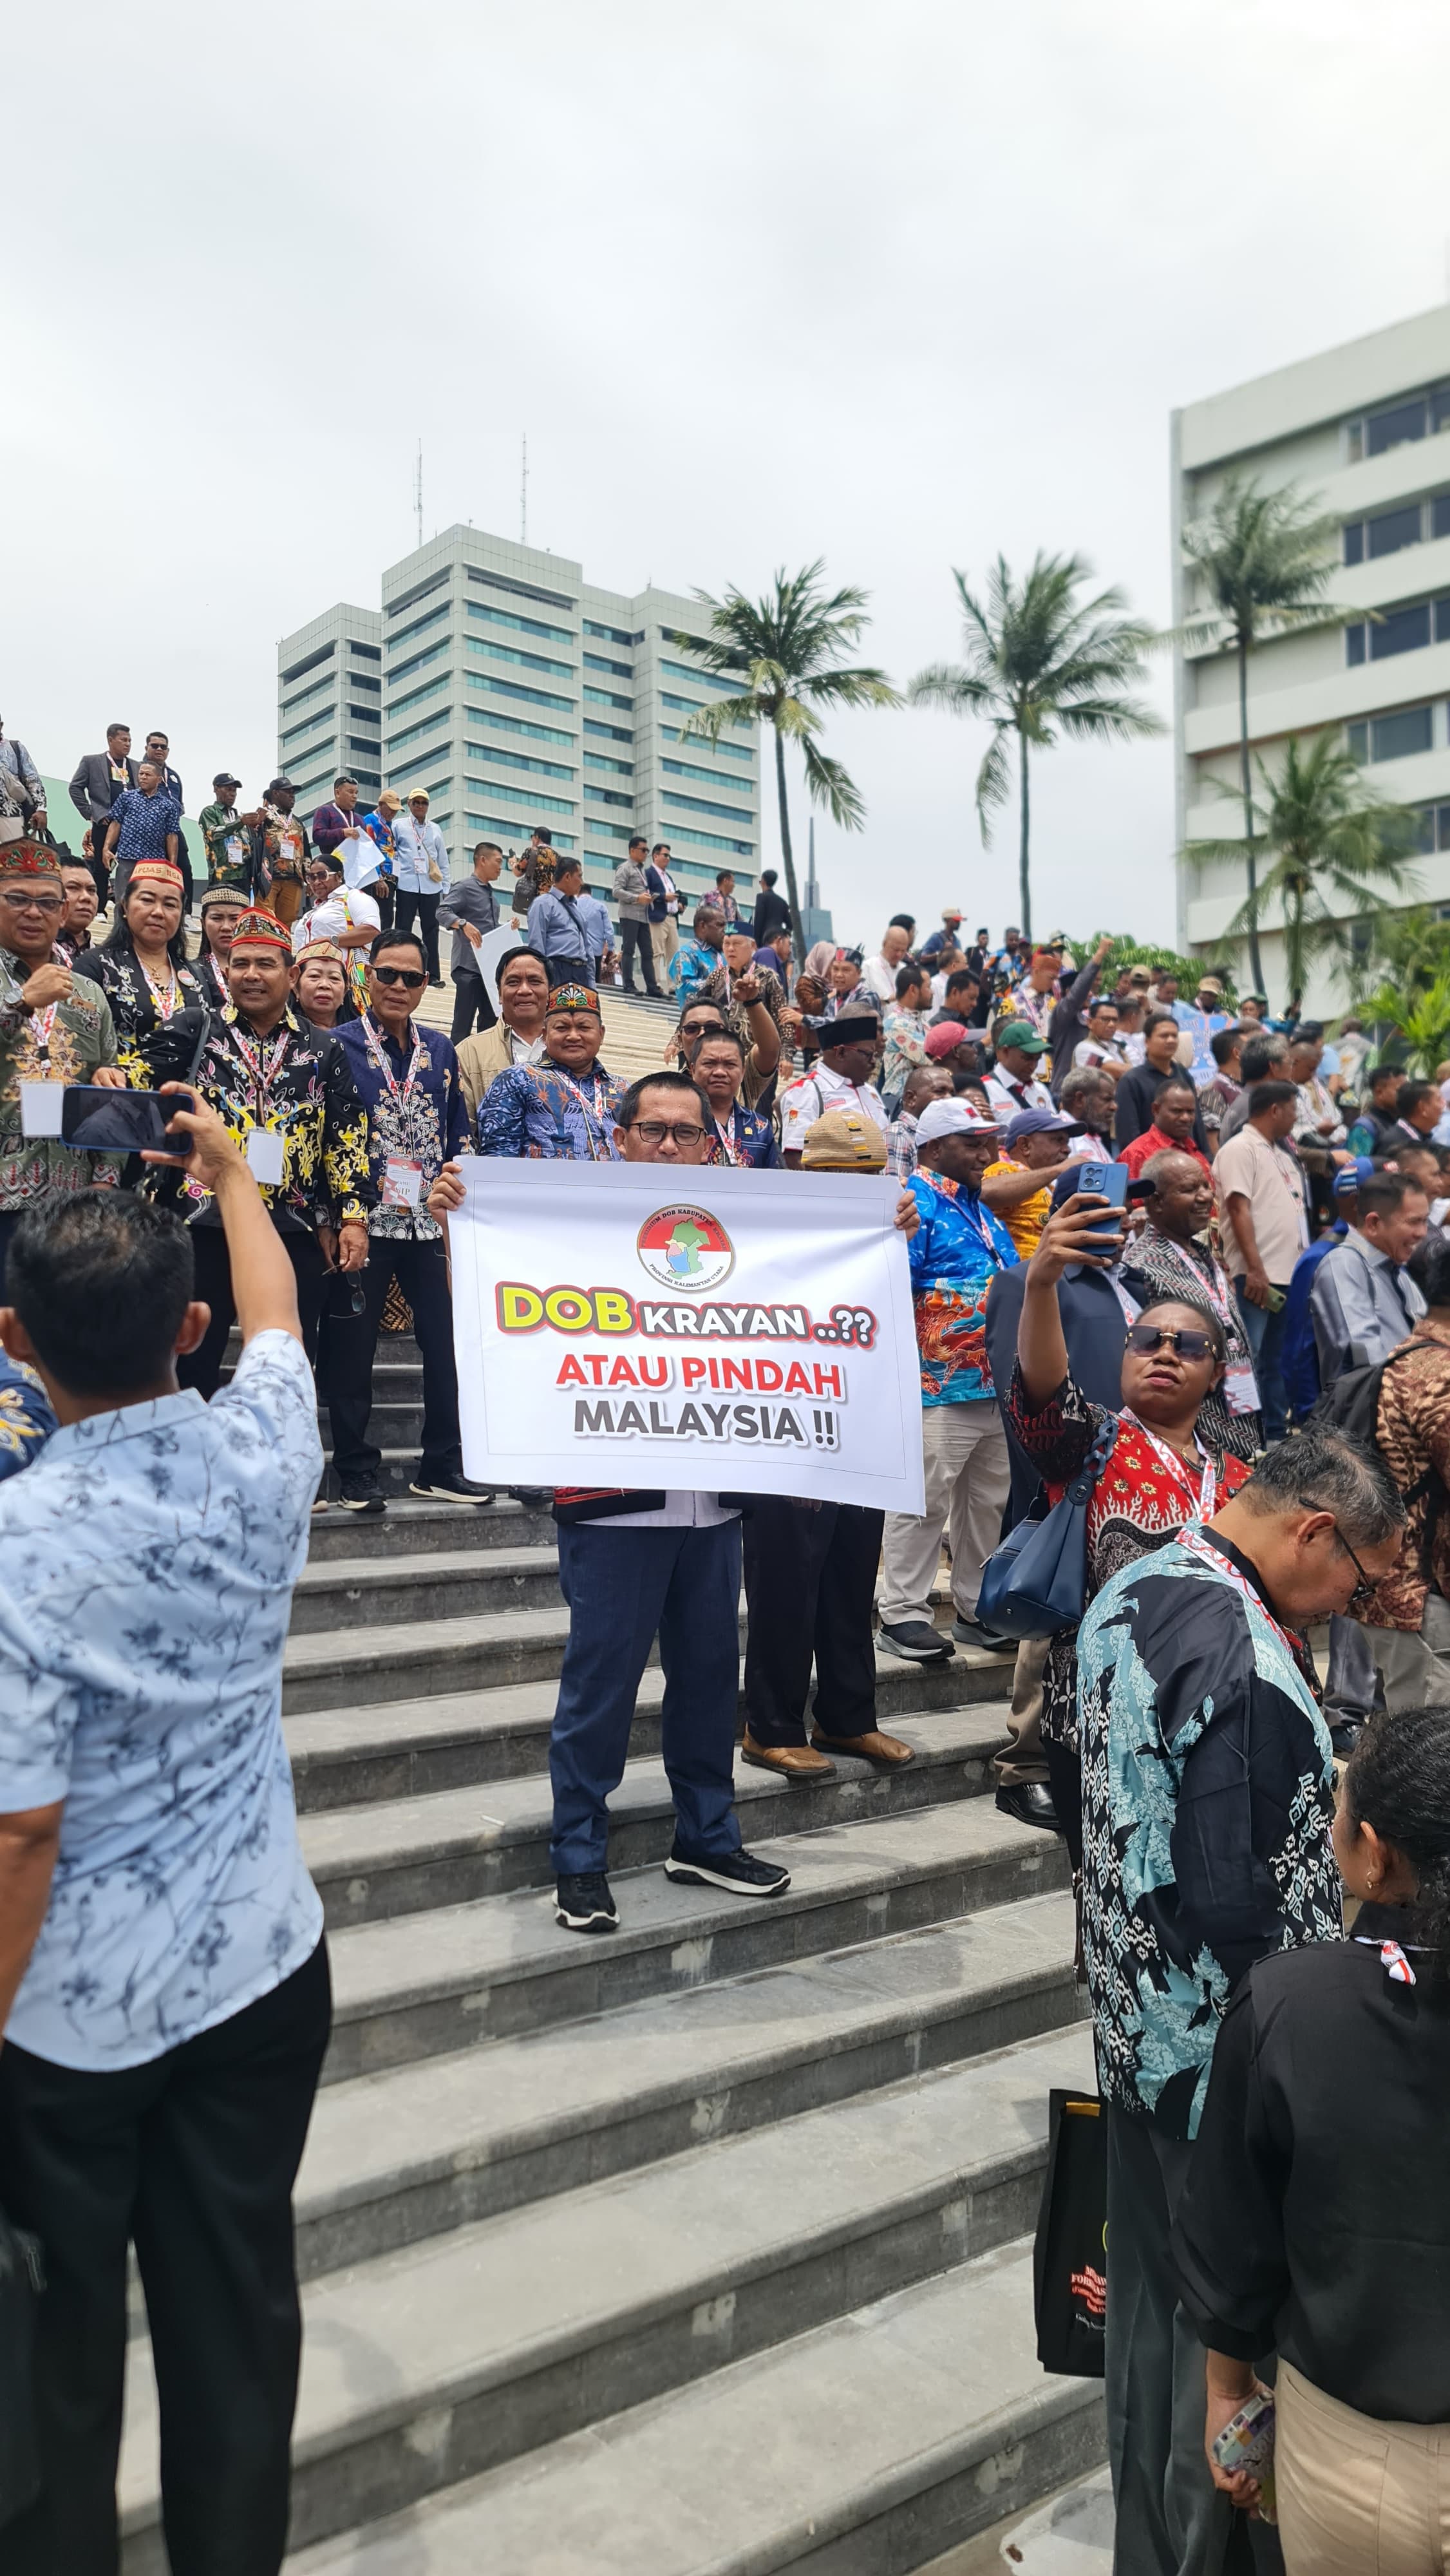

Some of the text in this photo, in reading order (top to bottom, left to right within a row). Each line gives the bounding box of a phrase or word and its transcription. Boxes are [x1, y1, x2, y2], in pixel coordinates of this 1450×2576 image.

[662, 1209, 676, 1218] DOB
[677, 1209, 713, 1227] KABUPATEN
[649, 1263, 724, 1287] PROVINSI KALIMANTAN UTARA
[500, 1285, 634, 1332] DOB
[643, 1305, 806, 1337] KRAYAN
[556, 1354, 842, 1397] ATAU PINDAH
[574, 1400, 803, 1442] MALAYSIA
